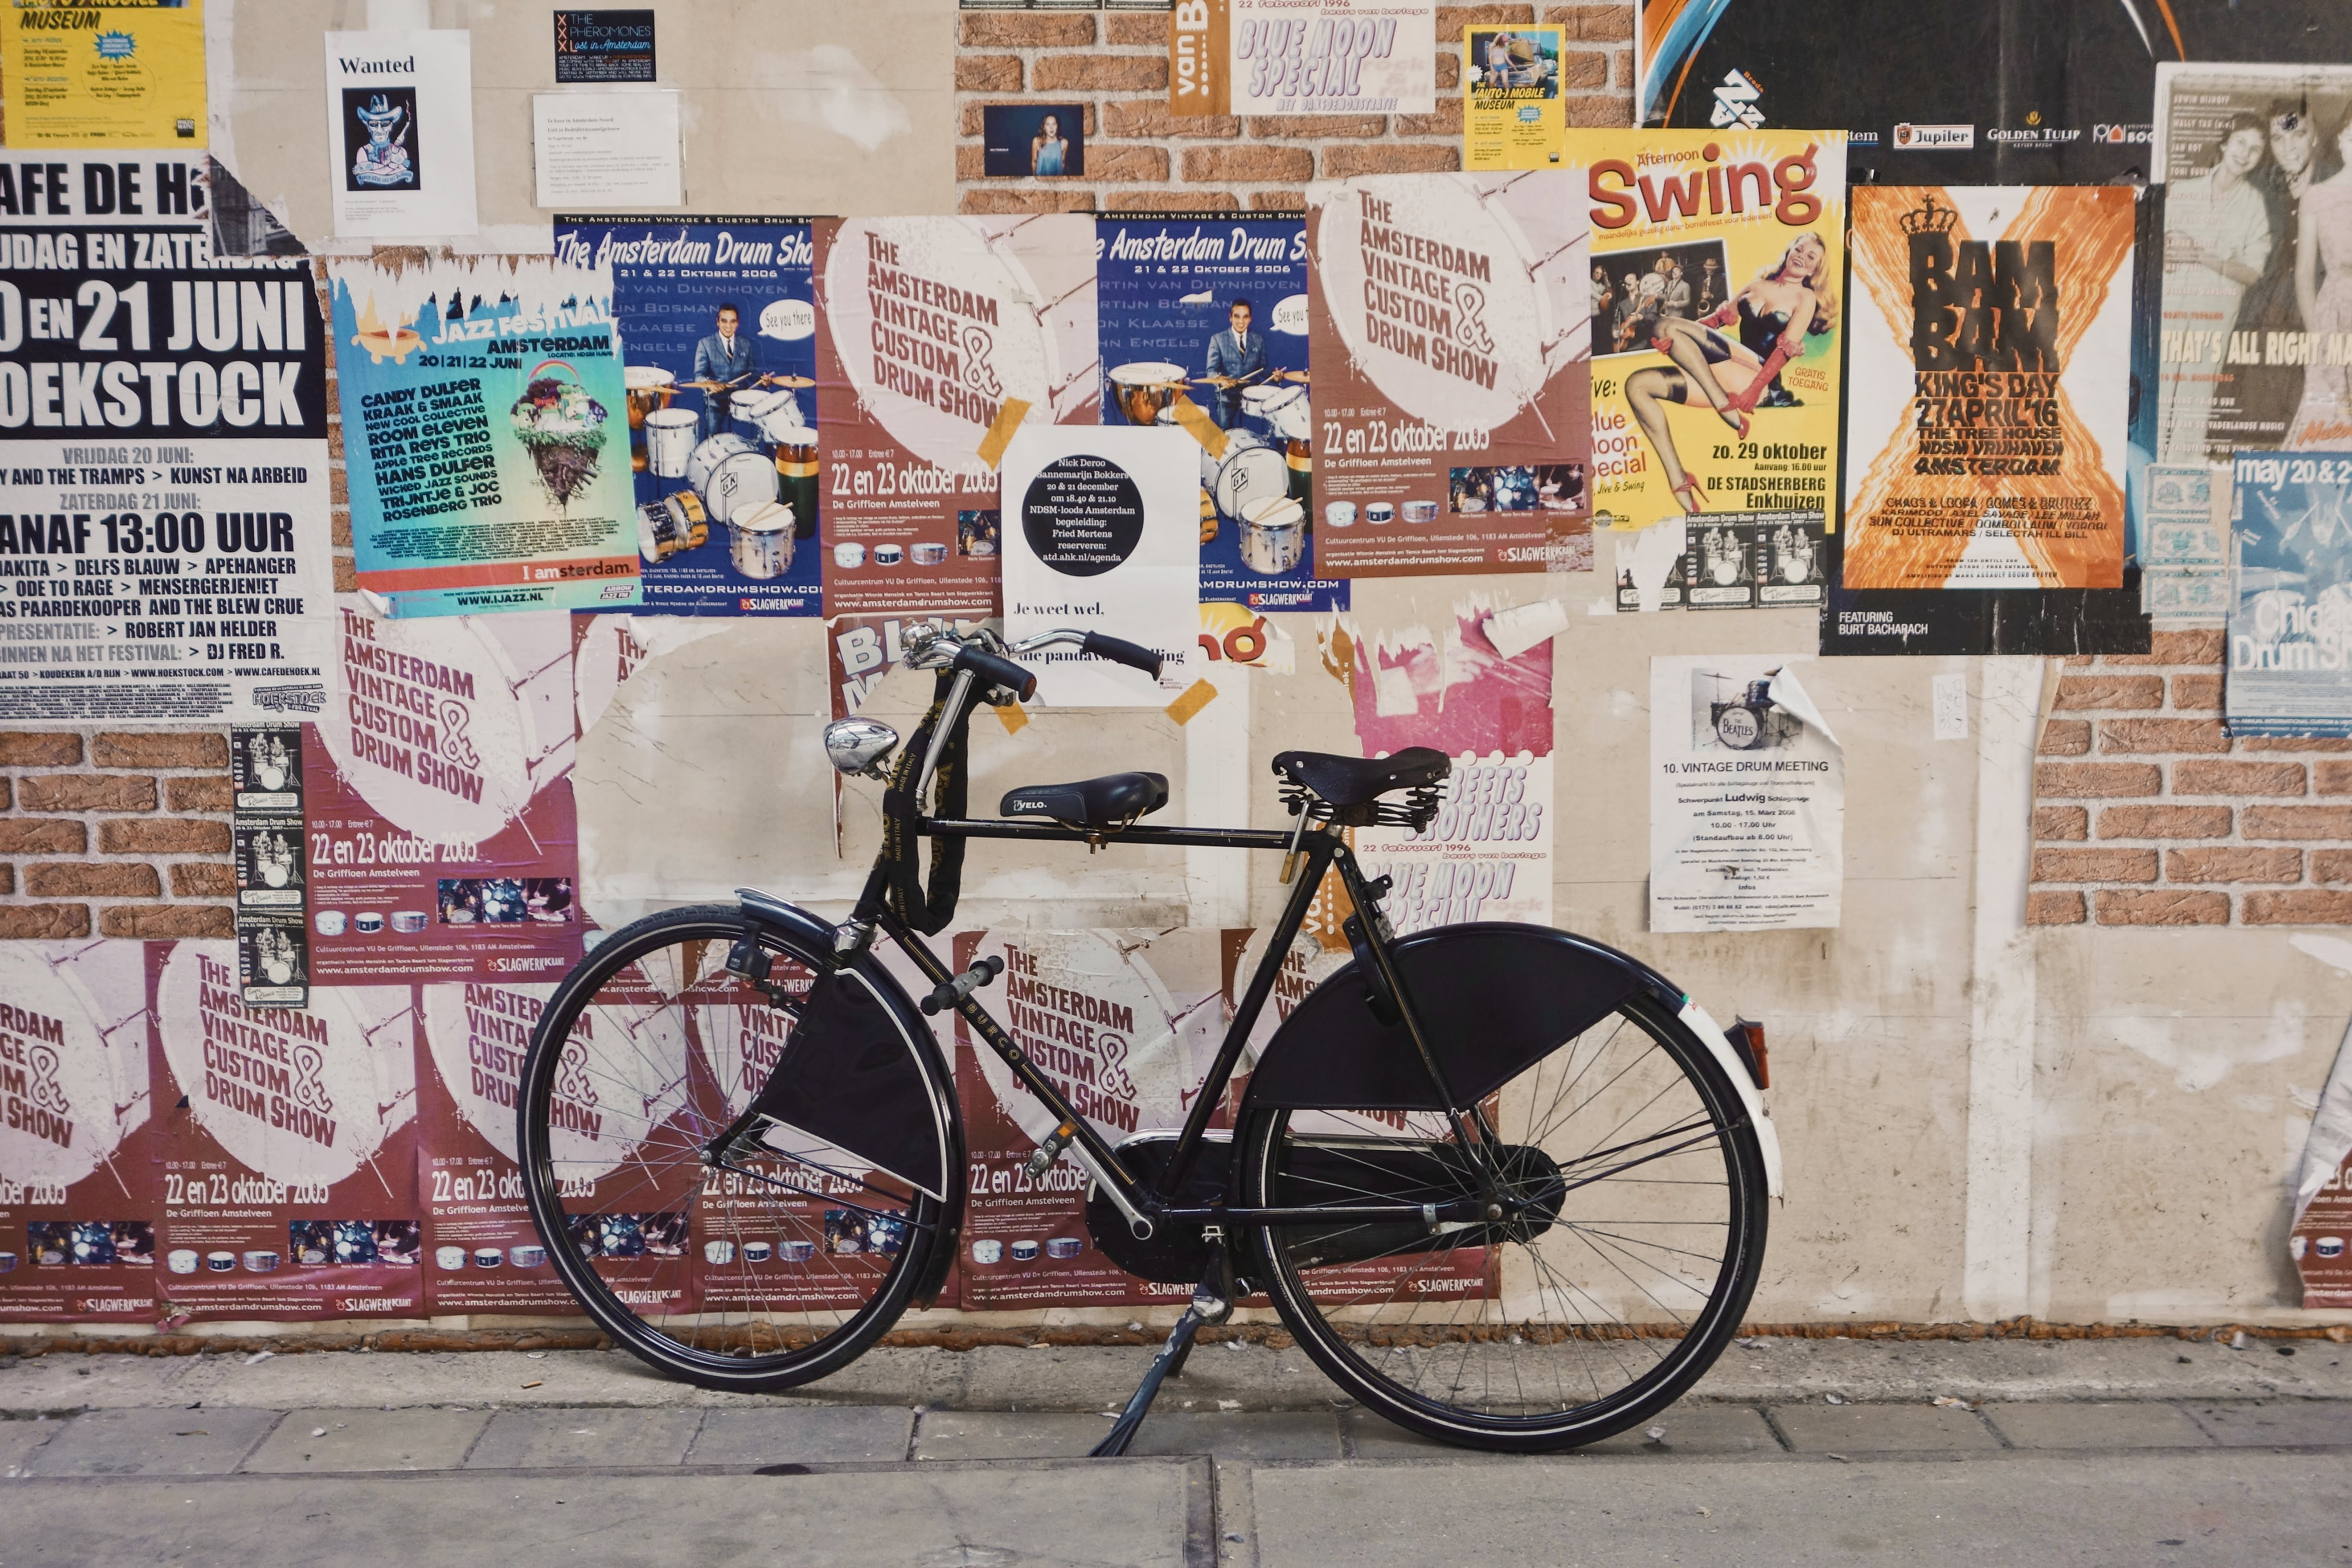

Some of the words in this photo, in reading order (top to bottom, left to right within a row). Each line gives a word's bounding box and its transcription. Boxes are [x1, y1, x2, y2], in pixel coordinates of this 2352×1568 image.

[20, 11, 101, 30] MUSEUM
[570, 14, 593, 24] THE
[570, 26, 651, 36] PHEROMONES
[1237, 18, 1306, 59] BLUE
[1309, 17, 1396, 58] MOON
[570, 40, 587, 52] Lost
[591, 41, 599, 49] in
[599, 40, 651, 50] Amsterdam
[339, 56, 415, 74] Wanted
[1249, 56, 1364, 97] SPECIAL
[1510, 88, 1545, 97] MOBILE
[1474, 100, 1515, 109] MUSEUM
[1914, 129, 1968, 144] Jupiler
[1637, 150, 1699, 167] Afternoon
[84, 163, 146, 215] DE
[1589, 142, 1822, 229] Swing
[1639, 226, 1664, 237] gezellig
[1685, 219, 1722, 229] borrelfeest
[1725, 216, 1739, 225] voor
[1741, 212, 1772, 222] iedereen!
[598, 231, 711, 265] Amsterdam
[715, 232, 772, 265] Drum
[865, 230, 899, 266] THE
[742, 270, 777, 278] 2006
[867, 260, 999, 326] AMSTERDAM
[29, 298, 73, 339] EN
[77, 280, 150, 350] 21
[168, 280, 306, 352] JUNI
[766, 312, 776, 328] See
[779, 315, 791, 331] you
[793, 312, 811, 326] there
[868, 289, 959, 347] VINTAGE
[872, 320, 960, 382] CUSTOM
[1366, 313, 1427, 365] DRUM
[1431, 341, 1498, 390] SHOW
[2162, 330, 2223, 363] THAT'S
[2227, 331, 2261, 364] ALL
[2265, 331, 2320, 365] RIGHT
[489, 357, 521, 369] JUNI
[1795, 367, 1825, 379] GRATIS
[1788, 376, 1829, 391] TOEGANG
[1916, 373, 2004, 398] KING'S
[2009, 373, 2059, 398] DAY
[361, 388, 416, 408] CANDY
[363, 405, 412, 421] KRAAK
[418, 401, 426, 412] &
[430, 392, 484, 410] SMAAK
[453, 432, 490, 446] TRIO
[1954, 428, 1998, 439] TREE
[2002, 427, 2061, 439] HOUSE
[1713, 445, 1734, 459] zo.
[1738, 443, 1758, 459] 29
[1763, 443, 1827, 460] oktober
[1058, 459, 1079, 467] Nick
[1080, 459, 1105, 467] Deroo
[1755, 463, 1790, 471] Aanvang:
[1792, 463, 1812, 471] 16.00
[1913, 458, 2062, 475] AMSTERDAM
[12, 469, 43, 484] AND
[48, 468, 75, 484] THE
[80, 468, 145, 484] TRAMPS
[171, 467, 221, 484] KUNST
[227, 467, 248, 483] NA
[252, 467, 307, 484] ARBEID
[375, 466, 426, 486] HANS
[454, 470, 497, 483] SOUNDS
[832, 463, 850, 495] 22
[854, 471, 873, 495] en
[877, 462, 895, 494] 23
[899, 461, 958, 495] oktober
[1037, 471, 1092, 479] Sannemarijn
[2237, 459, 2288, 491] may
[2291, 461, 2315, 484] 20
[1078, 482, 1118, 491] december
[1708, 478, 1722, 490] DE
[1726, 477, 1825, 491] STADSHERBERG
[833, 500, 845, 509] De
[847, 500, 886, 509] Griffioen
[889, 499, 939, 508] Amstelveen
[1030, 506, 1083, 514] NDSM-loods
[1085, 506, 1135, 514] Amsterdam
[1747, 493, 1825, 510] Enkhuizen
[1055, 518, 1106, 527] begeleiding:
[100, 512, 205, 553] 13:00
[217, 512, 293, 552] UUR
[1053, 529, 1075, 537] Fried
[1986, 530, 2042, 538] SELECTAH
[1043, 553, 1121, 563] atd.ahk.nl/agenda
[457, 593, 543, 605] WWW.IJAZZ.NL
[835, 597, 992, 608] www.amsterdamdrumshow.com
[21, 599, 141, 617] PAARDEKOOPER
[1014, 603, 1030, 615] Je
[1034, 604, 1070, 615] weet
[1074, 602, 1104, 617] wel,
[1839, 611, 1893, 623] FEATURING
[125, 621, 184, 638] ROBERT
[189, 621, 216, 637] JAN
[220, 620, 276, 637] HELDER
[1839, 624, 1864, 634] BURT
[2234, 634, 2314, 671] Drum
[131, 669, 223, 677] WWW.HOEKSTOCK.COM
[234, 668, 321, 676] WWW.CAFEDEHOEK.NL
[1723, 718, 1753, 736] BEATLES
[352, 725, 413, 780] DRUM
[418, 753, 483, 804] SHOW
[899, 774, 907, 792] MADE
[906, 753, 916, 768] ITALY
[1663, 764, 1678, 773] 10.
[1682, 762, 1733, 773] VINTAGE
[1736, 762, 1772, 772] DRUM
[1775, 761, 1829, 771] MEETING
[1447, 766, 1527, 804] BEETS
[1725, 794, 1765, 803] Ludwig
[235, 818, 267, 827] Amsterdam
[268, 818, 285, 827] Drum
[286, 818, 303, 827] Show
[317, 965, 473, 973] www.amsterdamdrumshow.com
[201, 1009, 291, 1065] VINTAGE
[966, 1004, 1020, 1060] BURCO
